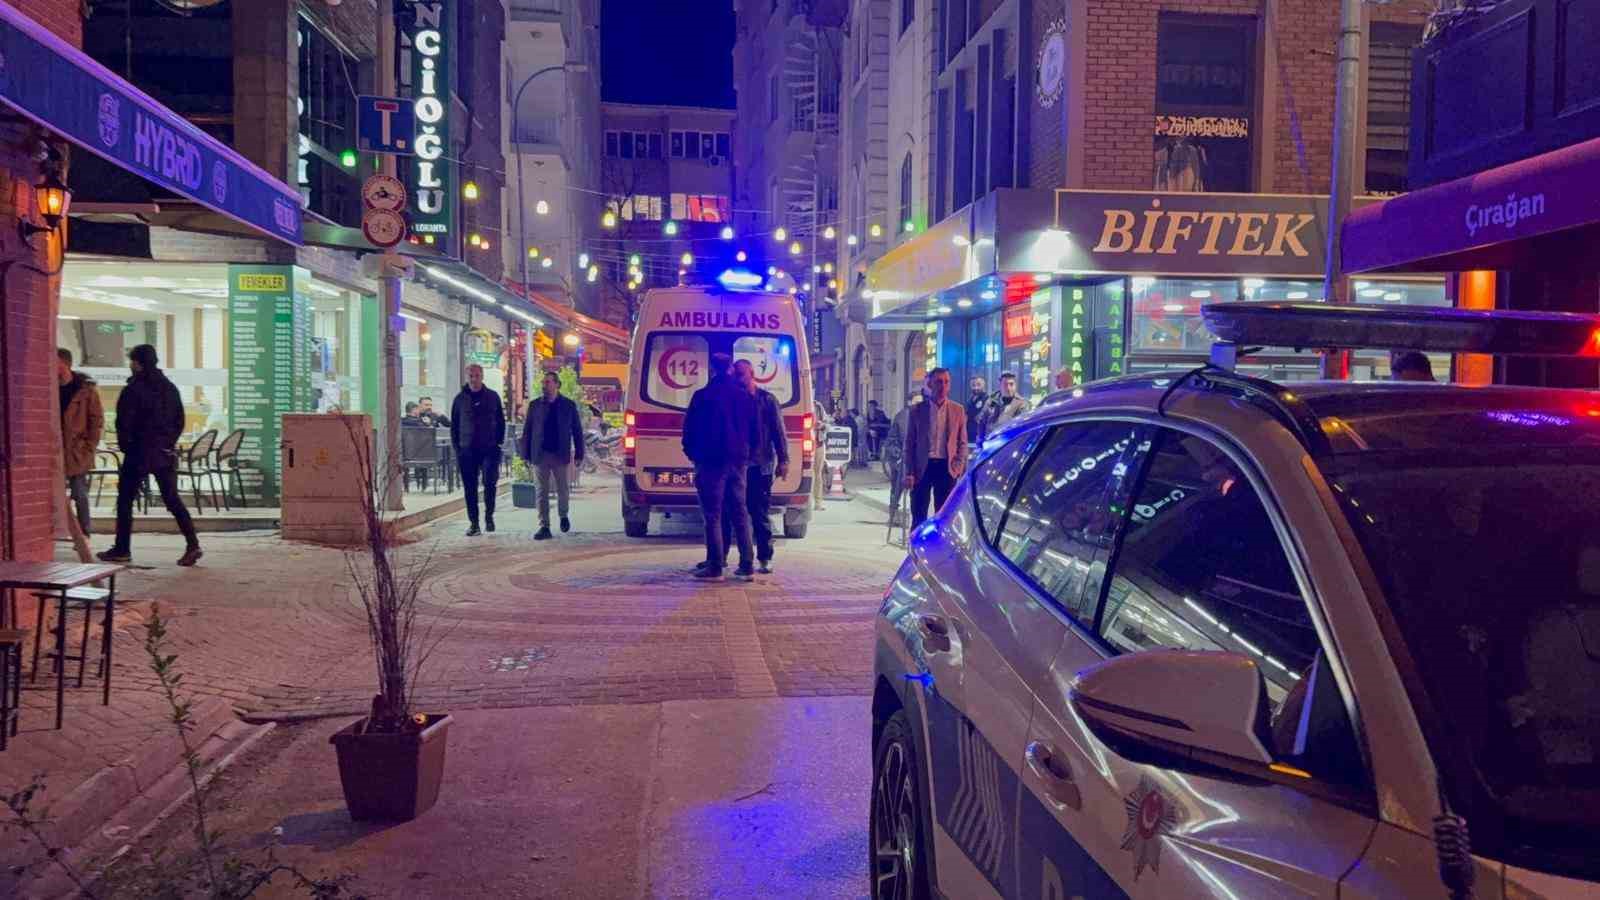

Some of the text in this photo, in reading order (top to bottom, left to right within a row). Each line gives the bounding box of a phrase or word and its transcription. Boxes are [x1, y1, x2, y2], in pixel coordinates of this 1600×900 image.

[414, 0, 445, 215] NCİOĞLU
[1092, 198, 1314, 258] BİFTEK
[1464, 191, 1545, 238] Çırağan
[659, 311, 781, 330] AMBULANS
[669, 360, 699, 377] 112
